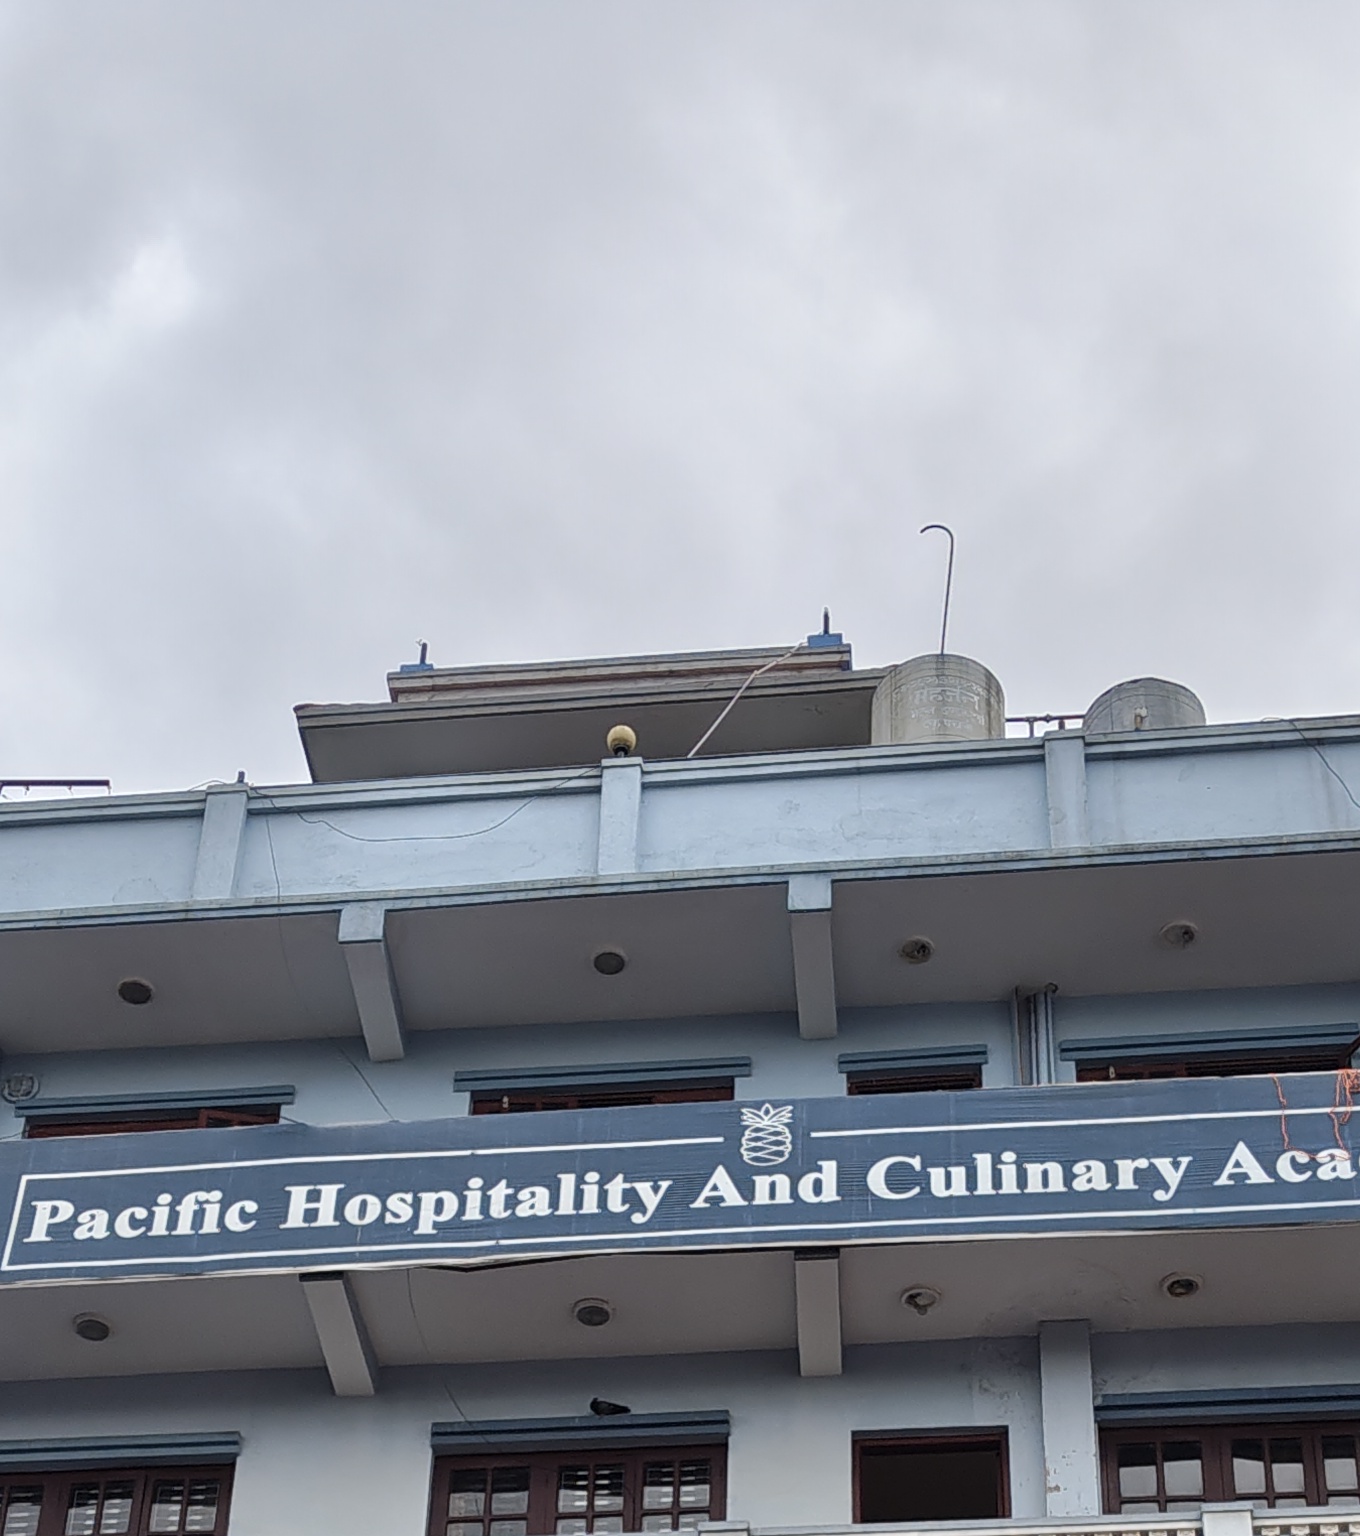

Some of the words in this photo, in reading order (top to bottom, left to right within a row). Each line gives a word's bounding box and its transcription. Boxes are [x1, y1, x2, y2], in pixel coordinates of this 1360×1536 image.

[23, 1190, 259, 1242] Pacific
[279, 1171, 673, 1236] Hospitality
[689, 1160, 842, 1209] And
[866, 1151, 1193, 1202] Culinary
